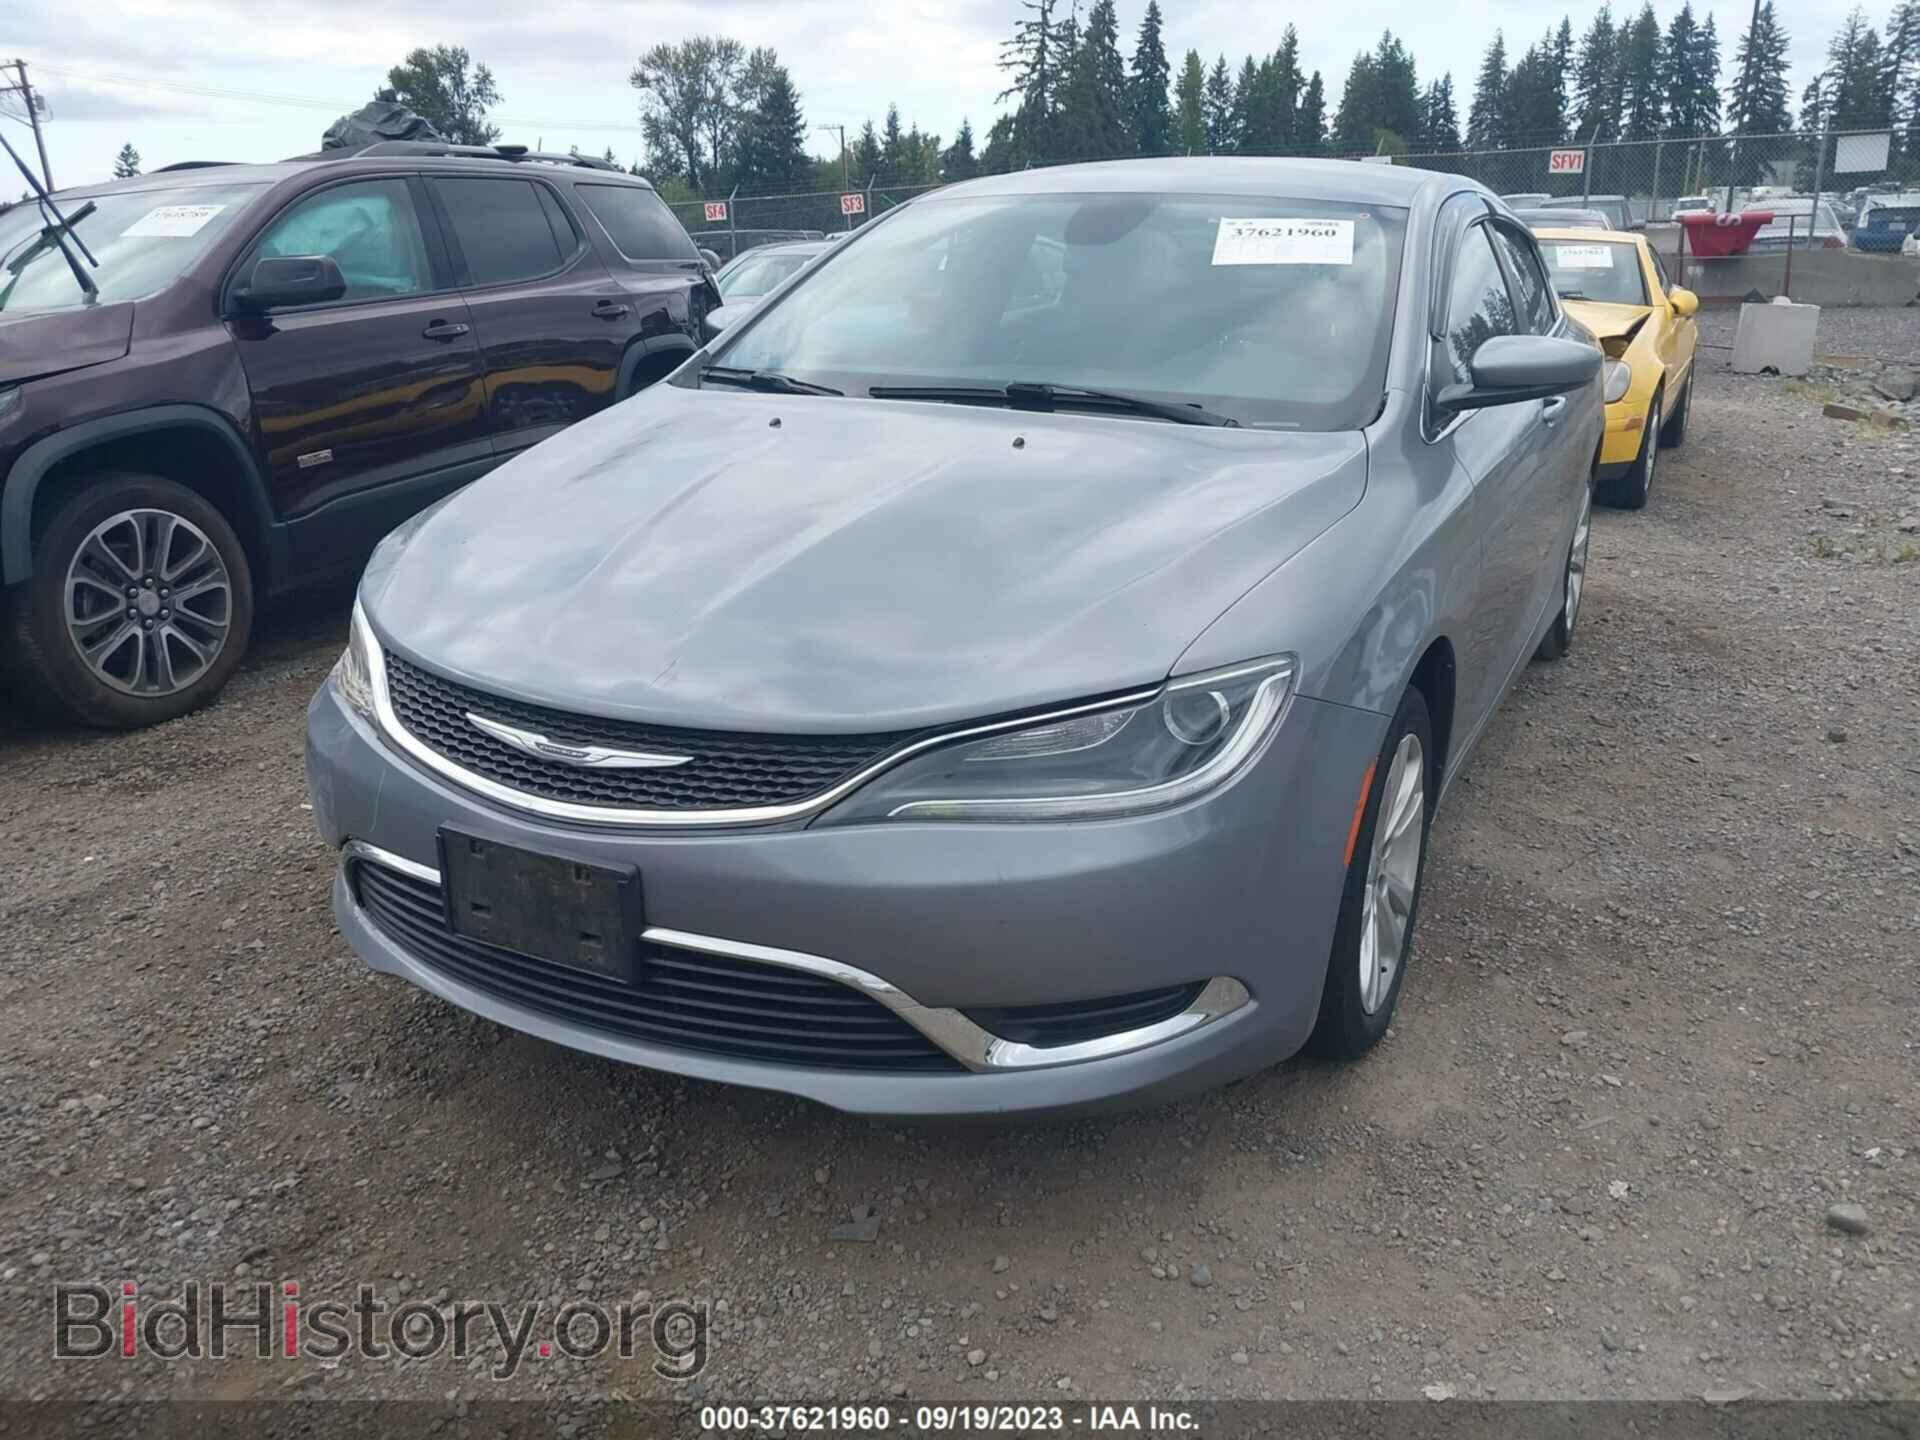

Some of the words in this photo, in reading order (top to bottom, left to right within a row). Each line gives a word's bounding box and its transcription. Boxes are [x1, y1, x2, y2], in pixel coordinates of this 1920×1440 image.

[1551, 153, 1583, 169] SFV1
[843, 196, 863, 212] SF3
[706, 205, 725, 219] SF4
[1233, 227, 1337, 238] 37621960
